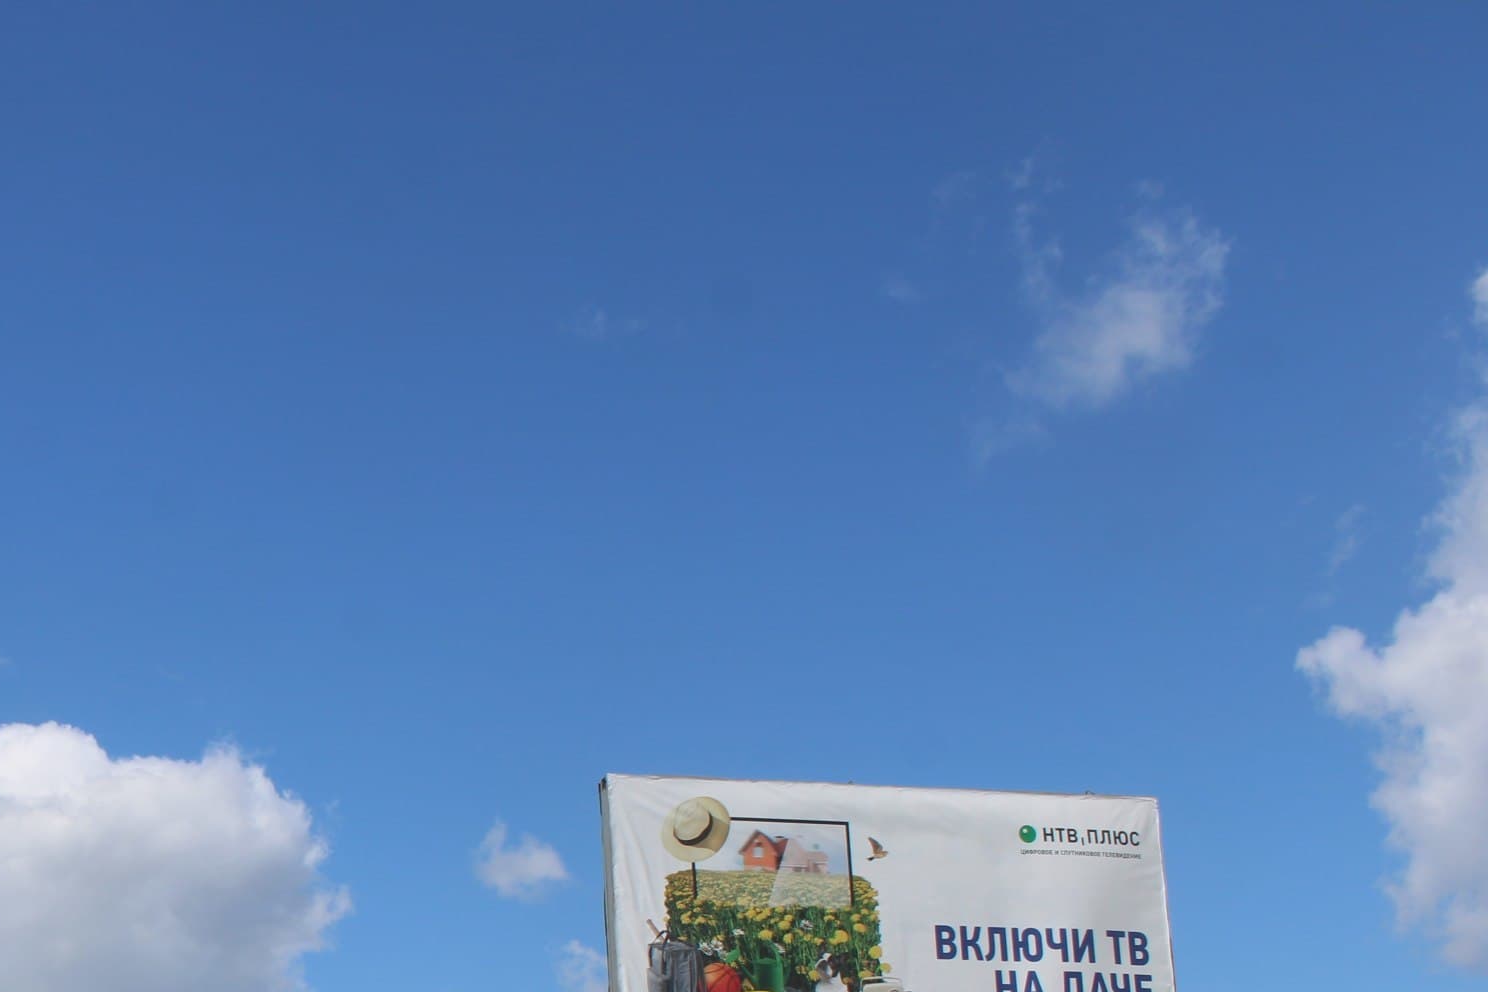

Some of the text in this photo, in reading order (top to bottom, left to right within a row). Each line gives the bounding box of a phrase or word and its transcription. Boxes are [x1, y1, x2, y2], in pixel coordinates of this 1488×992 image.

[1042, 827, 1140, 846] НТВ ПЛЮС
[934, 924, 1150, 966] ВКЛЮЧИ ТВ
